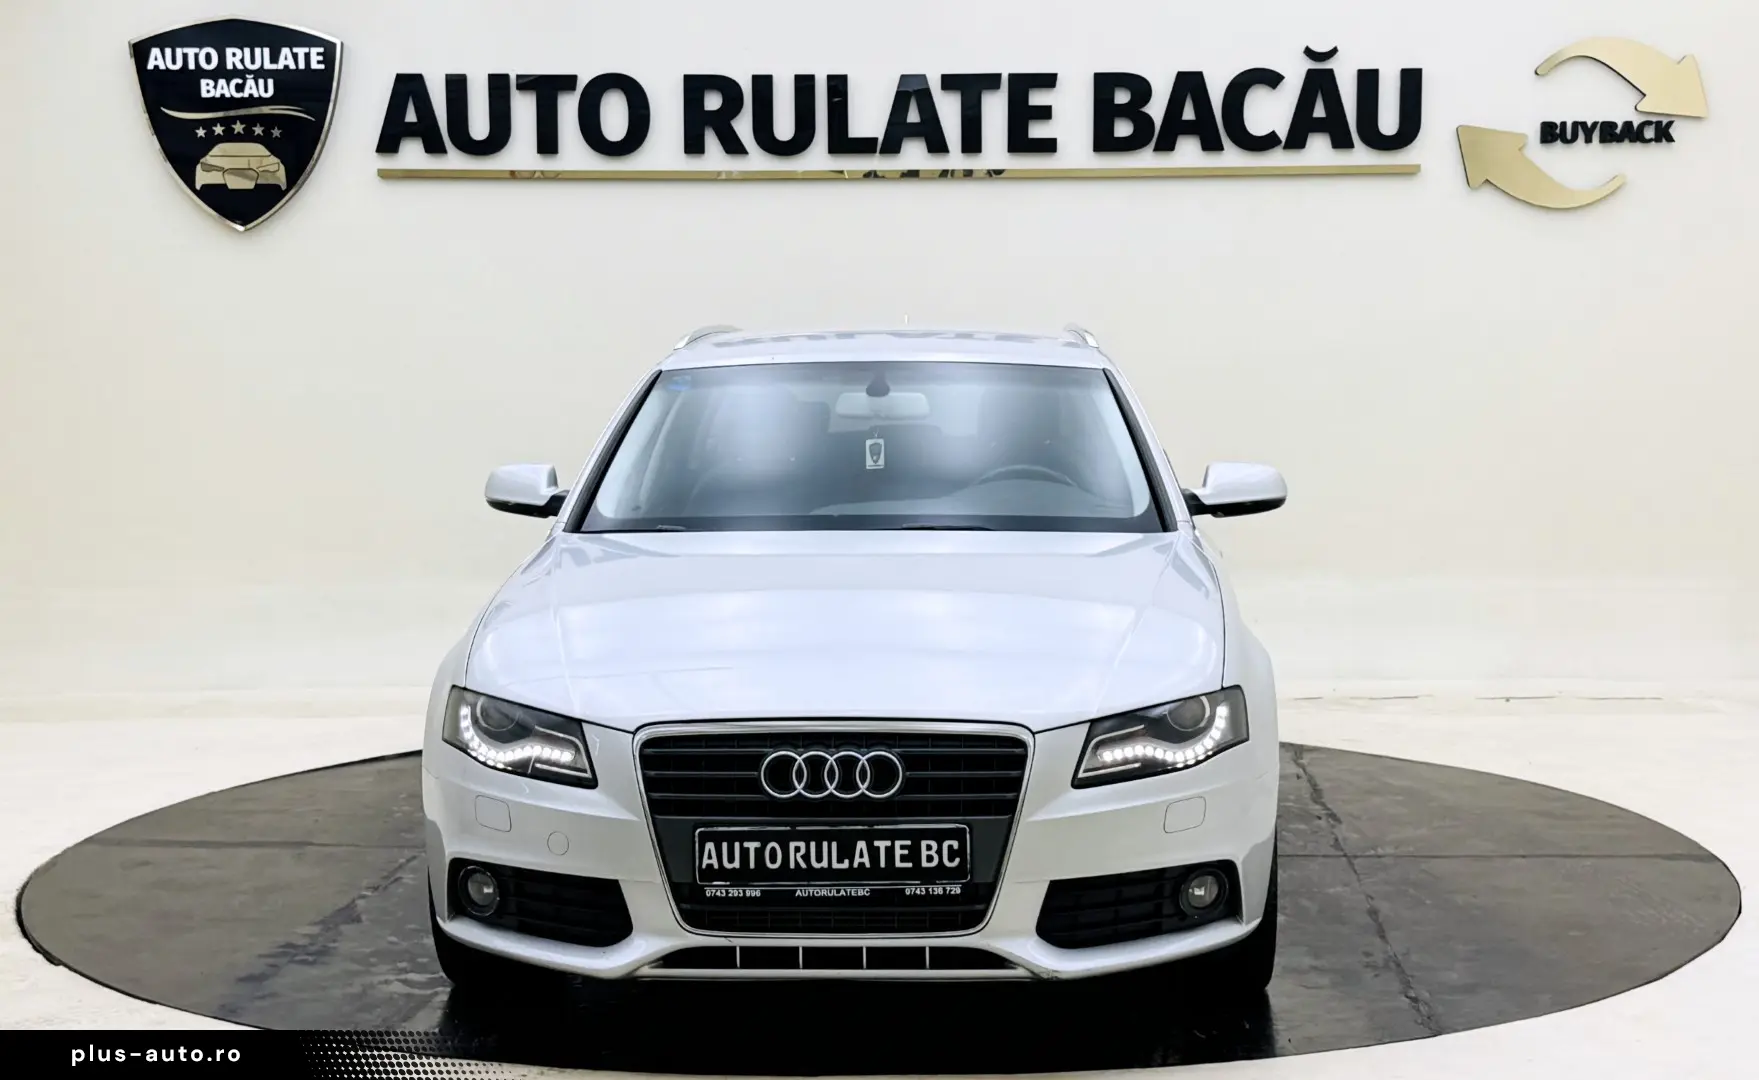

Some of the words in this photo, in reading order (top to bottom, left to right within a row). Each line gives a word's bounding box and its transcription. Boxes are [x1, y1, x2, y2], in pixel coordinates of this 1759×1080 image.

[147, 47, 218, 70] AUTO
[226, 47, 325, 70] RULATE
[201, 75, 274, 98] BACĂU
[376, 73, 650, 157] AUTO
[684, 73, 1057, 156] RULATE
[1093, 46, 1422, 152] BACĂU
[1540, 120, 1675, 144] BUYBACK
[702, 842, 782, 868] AUTO
[790, 841, 912, 868] RULATE
[921, 840, 960, 867] BC
[796, 889, 870, 897] AUTORULATEBC
[905, 888, 925, 896] 0743
